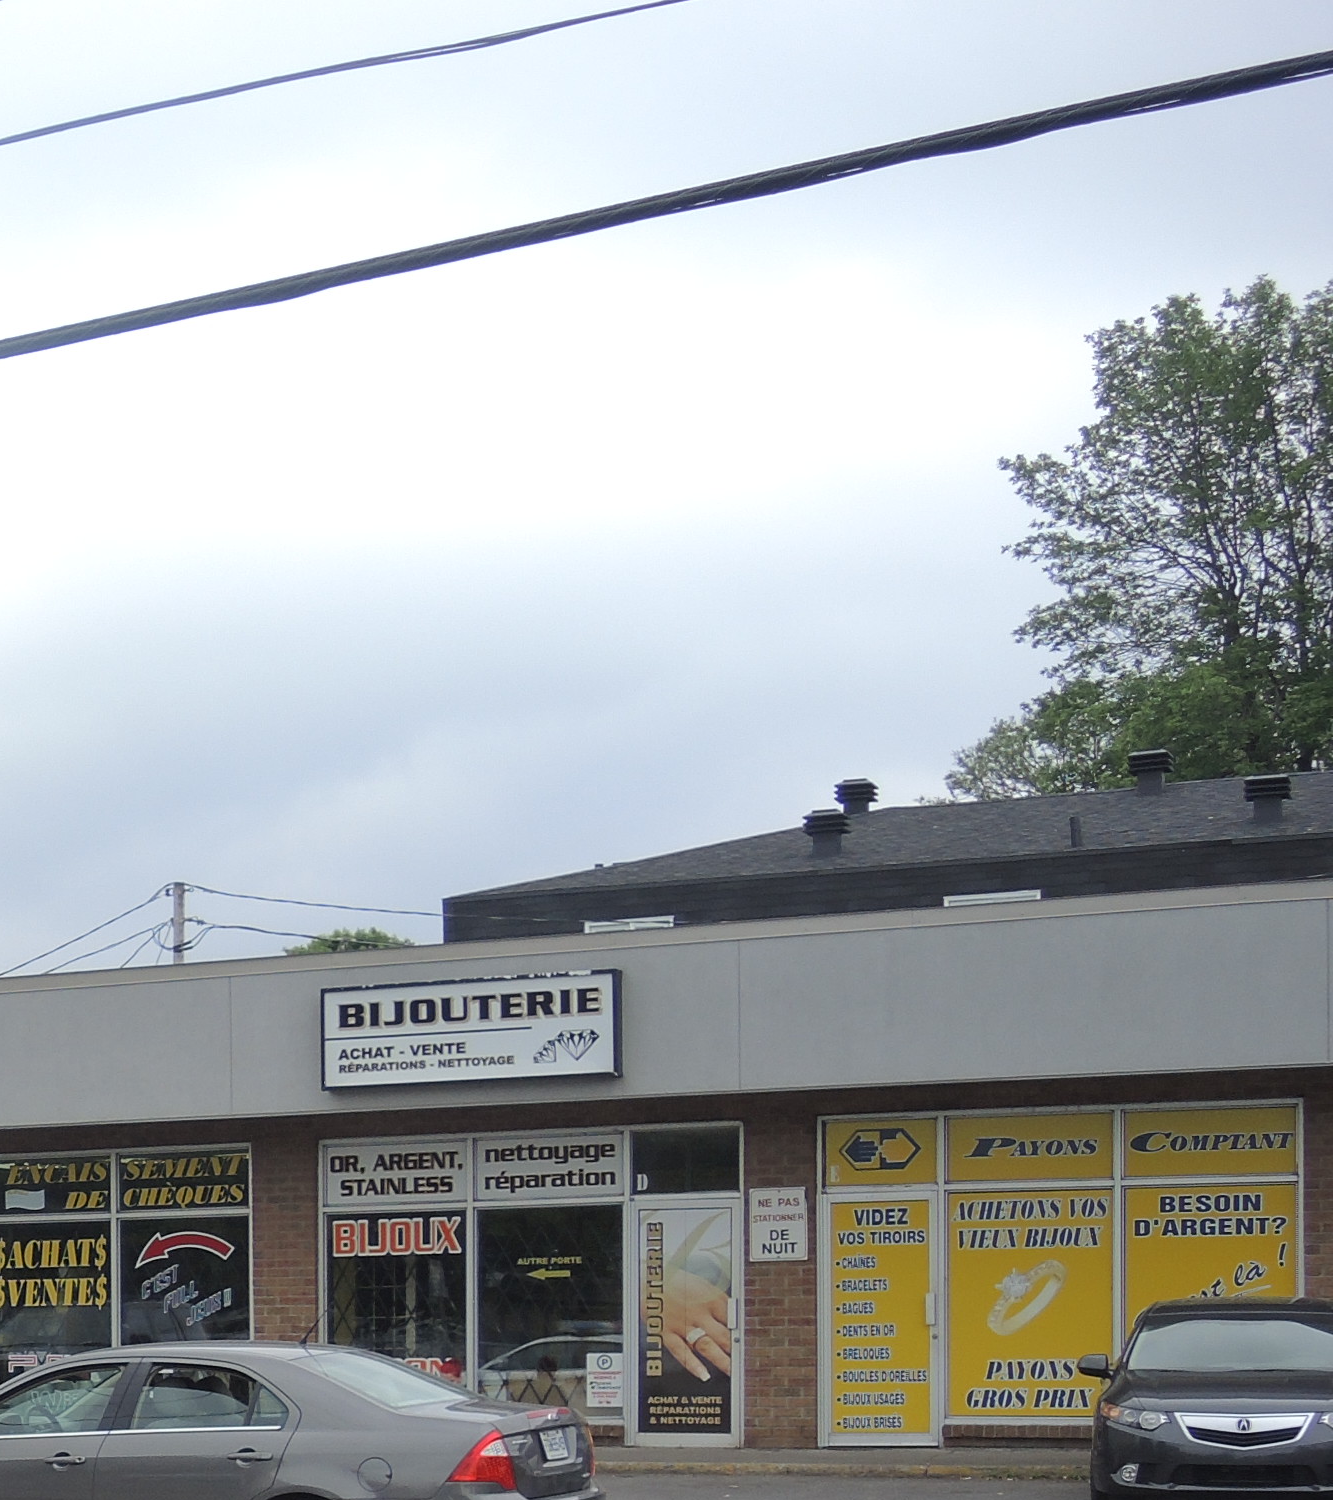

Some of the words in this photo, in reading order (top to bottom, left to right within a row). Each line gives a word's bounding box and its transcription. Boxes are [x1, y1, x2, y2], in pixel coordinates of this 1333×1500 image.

[337, 987, 602, 1029] BIJOUTERIE
[338, 1046, 395, 1061] ACHAT
[410, 1042, 466, 1056] VENTE
[338, 1060, 426, 1074] RÉPARATIONS
[438, 1055, 515, 1069] NETTOYAGE
[329, 1155, 366, 1175] OR,
[373, 1150, 464, 1172] ARGENT,
[484, 1142, 616, 1164] nettoyage
[340, 1176, 454, 1197] STAINLESS
[484, 1170, 617, 1194] réparation
[636, 1173, 649, 1192] D
[63, 1189, 108, 1210] DE
[122, 1181, 246, 1209] CHÈQUES
[758, 1198, 773, 1208] NE
[777, 1197, 800, 1207] PAS
[1159, 1193, 1262, 1214] BESOIN
[753, 1212, 804, 1224] STATIONNER
[853, 1207, 909, 1227] VIDEZ
[954, 1198, 1061, 1222] ACHETONS
[1069, 1197, 1109, 1219] VOS
[770, 1228, 790, 1241] DE
[1133, 1216, 1289, 1237] D'ARGENT?
[333, 1215, 463, 1259] BIJOUX
[837, 1231, 865, 1245] VOS
[869, 1229, 926, 1245] TIROIRS
[957, 1227, 1020, 1250] VIEUX
[1024, 1225, 1102, 1249] BIJOUX
[761, 1241, 798, 1255] NUIT
[516, 1257, 549, 1266] AUTRE
[550, 1255, 583, 1265] PORTE
[1233, 1259, 1266, 1287] là
[841, 1278, 888, 1292] BRACELETS
[646, 1221, 664, 1378] BIJOUTERIE
[842, 1302, 874, 1315] BAGUES
[842, 1325, 869, 1337] DENTS
[870, 1324, 881, 1336] EN
[883, 1324, 895, 1336] OR
[842, 1347, 891, 1360] BRELOQUES
[842, 1370, 879, 1383] BOUCLES
[985, 1360, 1074, 1381] PAYONS
[647, 1396, 679, 1405] ACHAT
[690, 1396, 723, 1405] VENTE
[842, 1393, 872, 1406] BIJOUX
[965, 1389, 1028, 1410] GROS
[1033, 1388, 1091, 1410] PRIX
[649, 1405, 722, 1415] RÉPARATIONS
[660, 1415, 722, 1425] NETTOYAGE
[842, 1416, 872, 1429] BIJOUX
